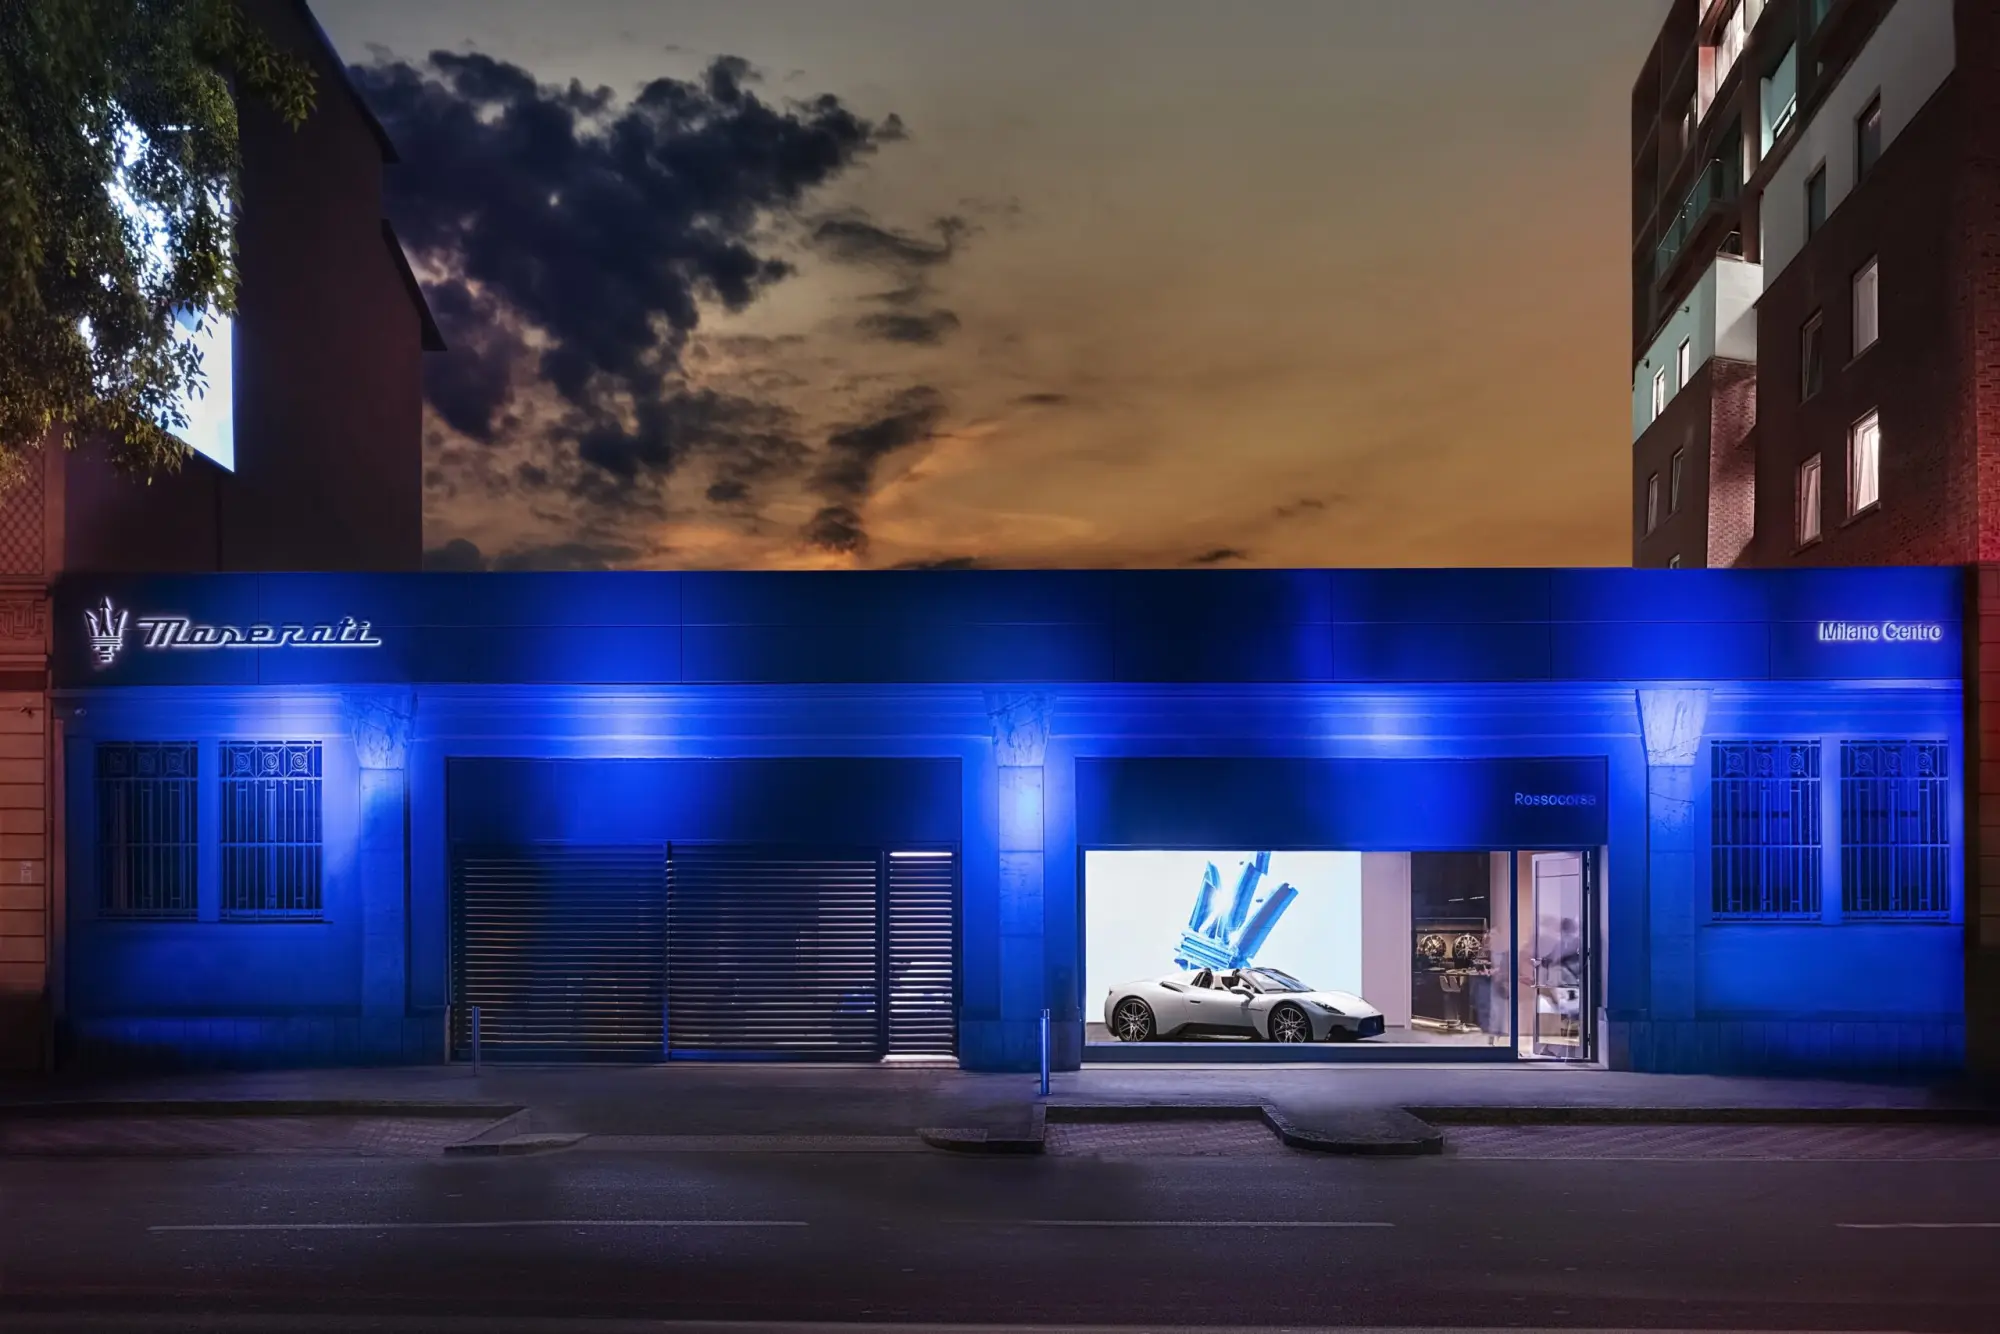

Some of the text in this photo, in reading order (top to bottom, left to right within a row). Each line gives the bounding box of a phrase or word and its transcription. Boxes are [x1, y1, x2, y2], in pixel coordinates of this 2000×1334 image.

[136, 616, 382, 647] Maserati
[1818, 621, 1943, 641] Milano Centro
[1514, 792, 1597, 806] Rossocorsa
